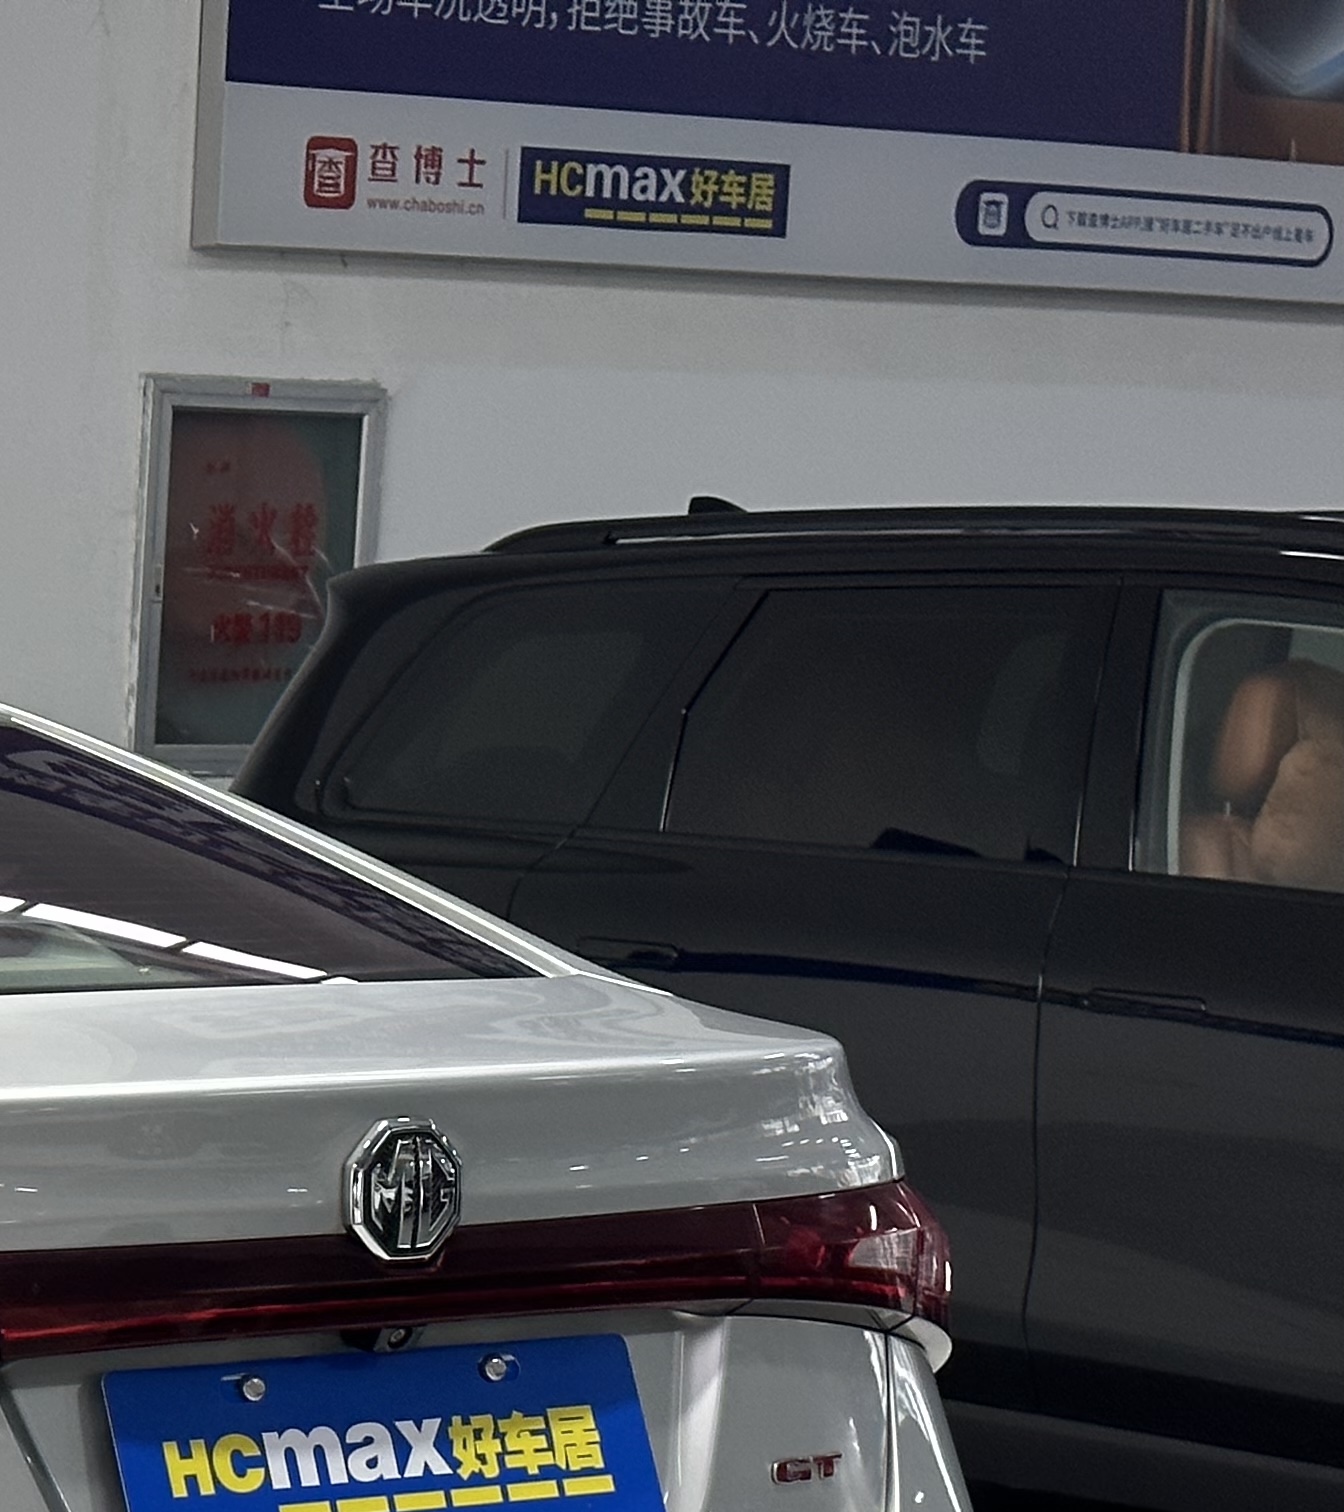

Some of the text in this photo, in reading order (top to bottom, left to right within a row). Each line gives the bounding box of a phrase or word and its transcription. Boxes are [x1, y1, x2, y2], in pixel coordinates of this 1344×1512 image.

[367, 142, 487, 188] 查博士
[367, 196, 485, 215] www.chaboshi.cn
[771, 1452, 843, 1484] GT
